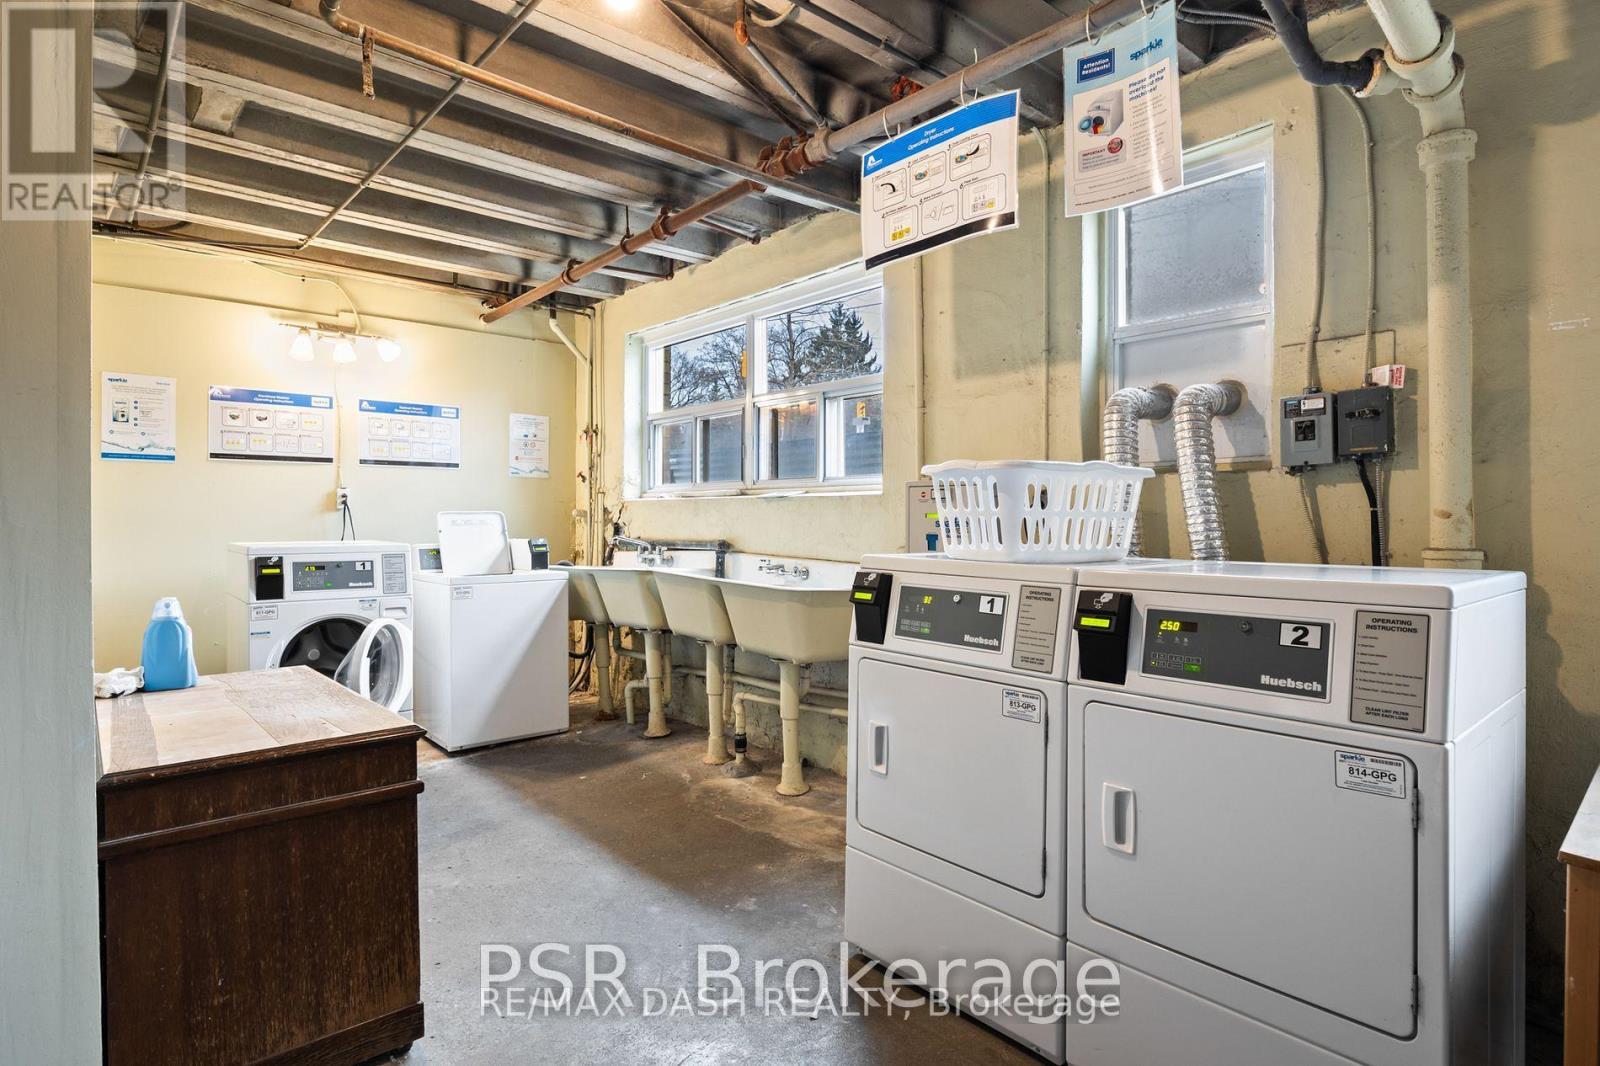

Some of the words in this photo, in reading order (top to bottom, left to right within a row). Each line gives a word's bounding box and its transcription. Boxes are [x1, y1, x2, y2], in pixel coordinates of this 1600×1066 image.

[1129, 38, 1163, 61] sparkle
[1083, 58, 1109, 69] Attention
[1156, 66, 1166, 77] not
[1128, 79, 1154, 95] overlod
[1128, 85, 1158, 102] machies!
[986, 598, 995, 612] 1
[1160, 620, 1180, 631] 250
[1371, 617, 1413, 626] OPERATING
[1290, 625, 1310, 647] 2
[1365, 624, 1418, 634] INSTRUCTIONS
[964, 634, 999, 646] Huebsch
[1261, 674, 1321, 691] Huebsch
[1348, 766, 1398, 782] 814-GPG
